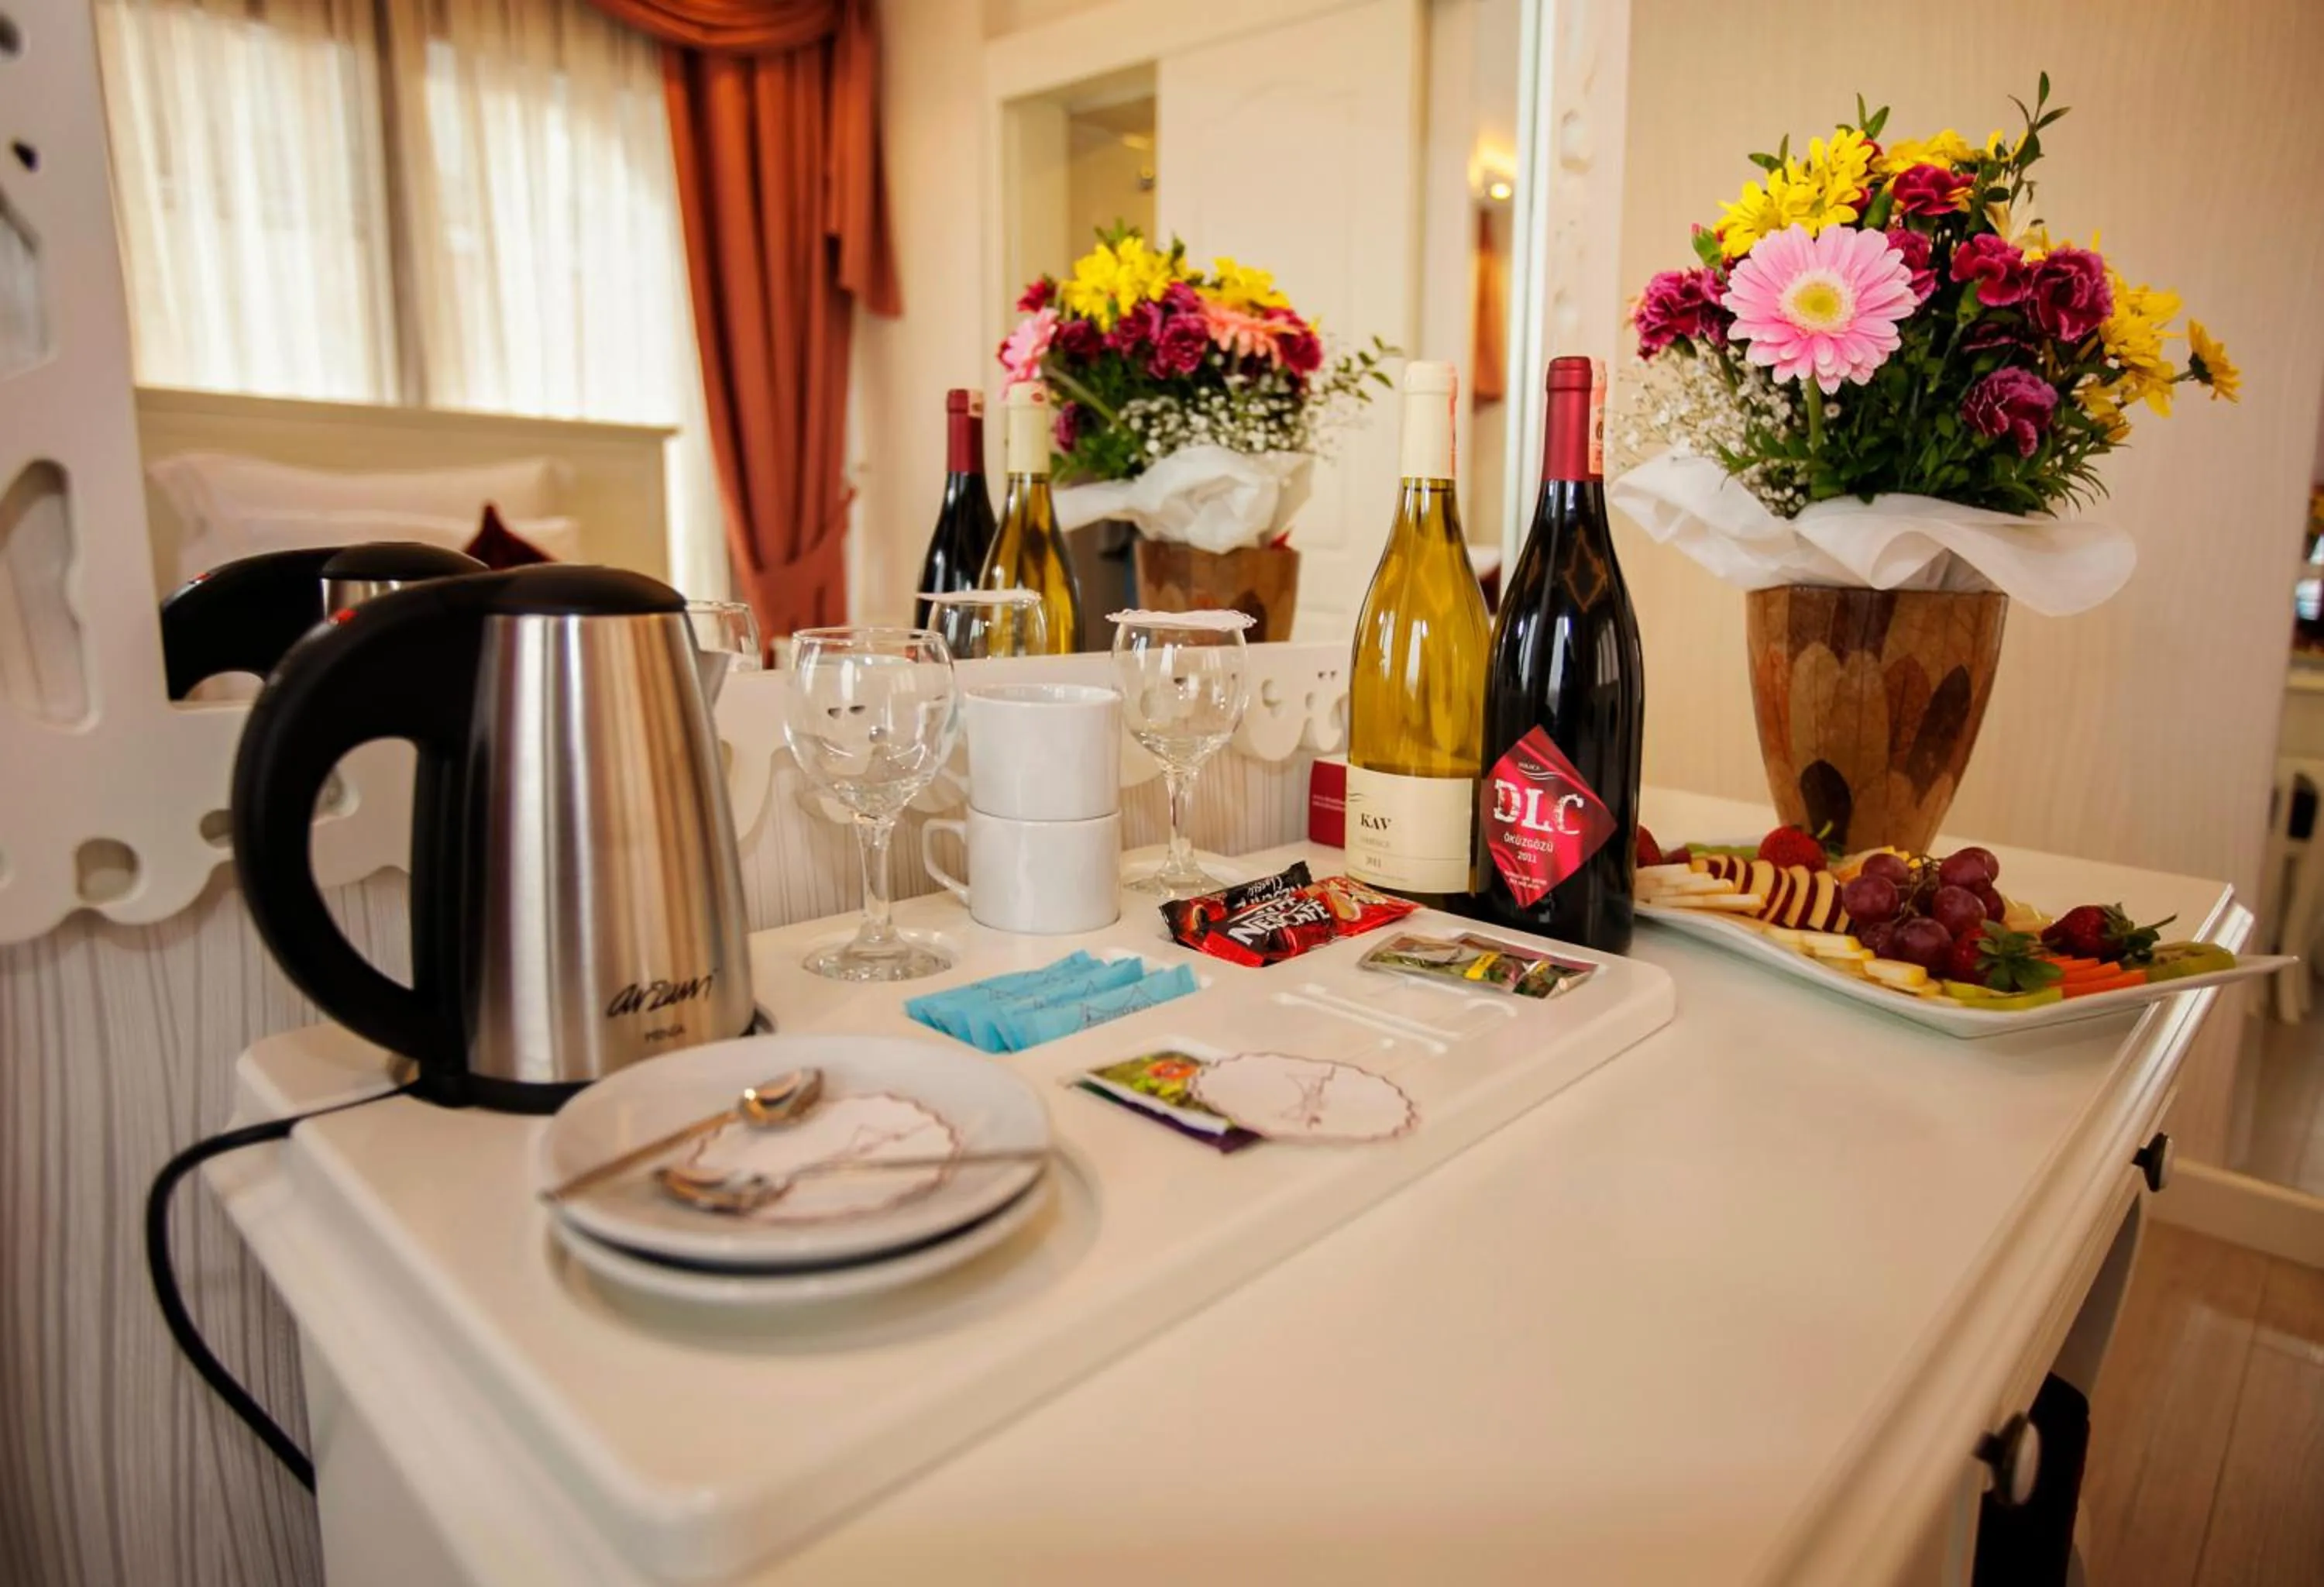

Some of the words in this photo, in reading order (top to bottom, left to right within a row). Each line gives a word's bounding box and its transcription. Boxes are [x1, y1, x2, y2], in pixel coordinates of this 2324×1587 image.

[1493, 779, 1584, 835] DLC
[1361, 813, 1391, 830] KAV
[1518, 851, 1537, 863] 2011
